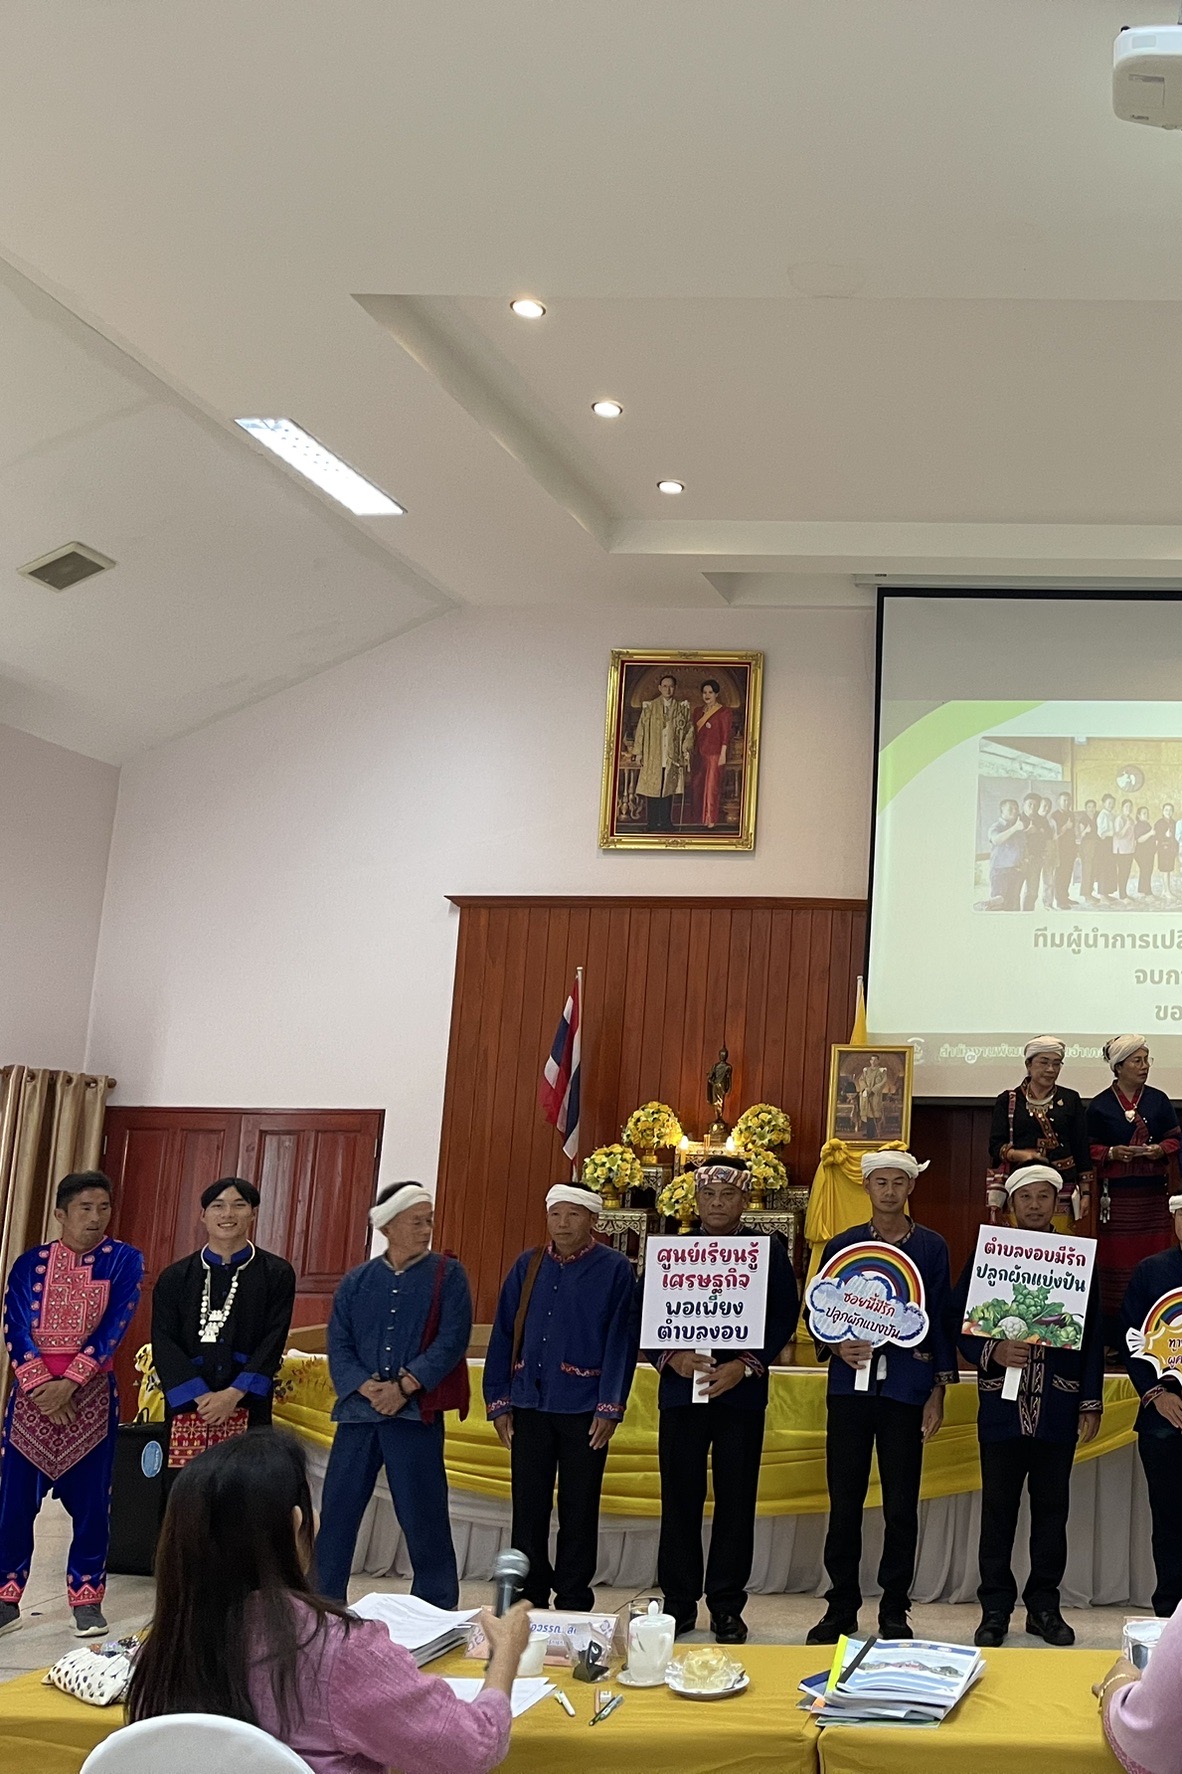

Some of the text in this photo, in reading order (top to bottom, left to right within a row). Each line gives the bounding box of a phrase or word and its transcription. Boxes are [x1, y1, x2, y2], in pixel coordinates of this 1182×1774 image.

[657, 1241, 760, 1271] ศูนย์เรียนรู้
[984, 1236, 1087, 1267] ตำบลงอบมีรัก
[662, 1267, 751, 1295] เศรษฐกิจ
[976, 1263, 1086, 1293] ปลูกผักแบ่งปัน
[665, 1294, 744, 1316] พอเพียง
[657, 1318, 749, 1340] ตำบลงอบ
